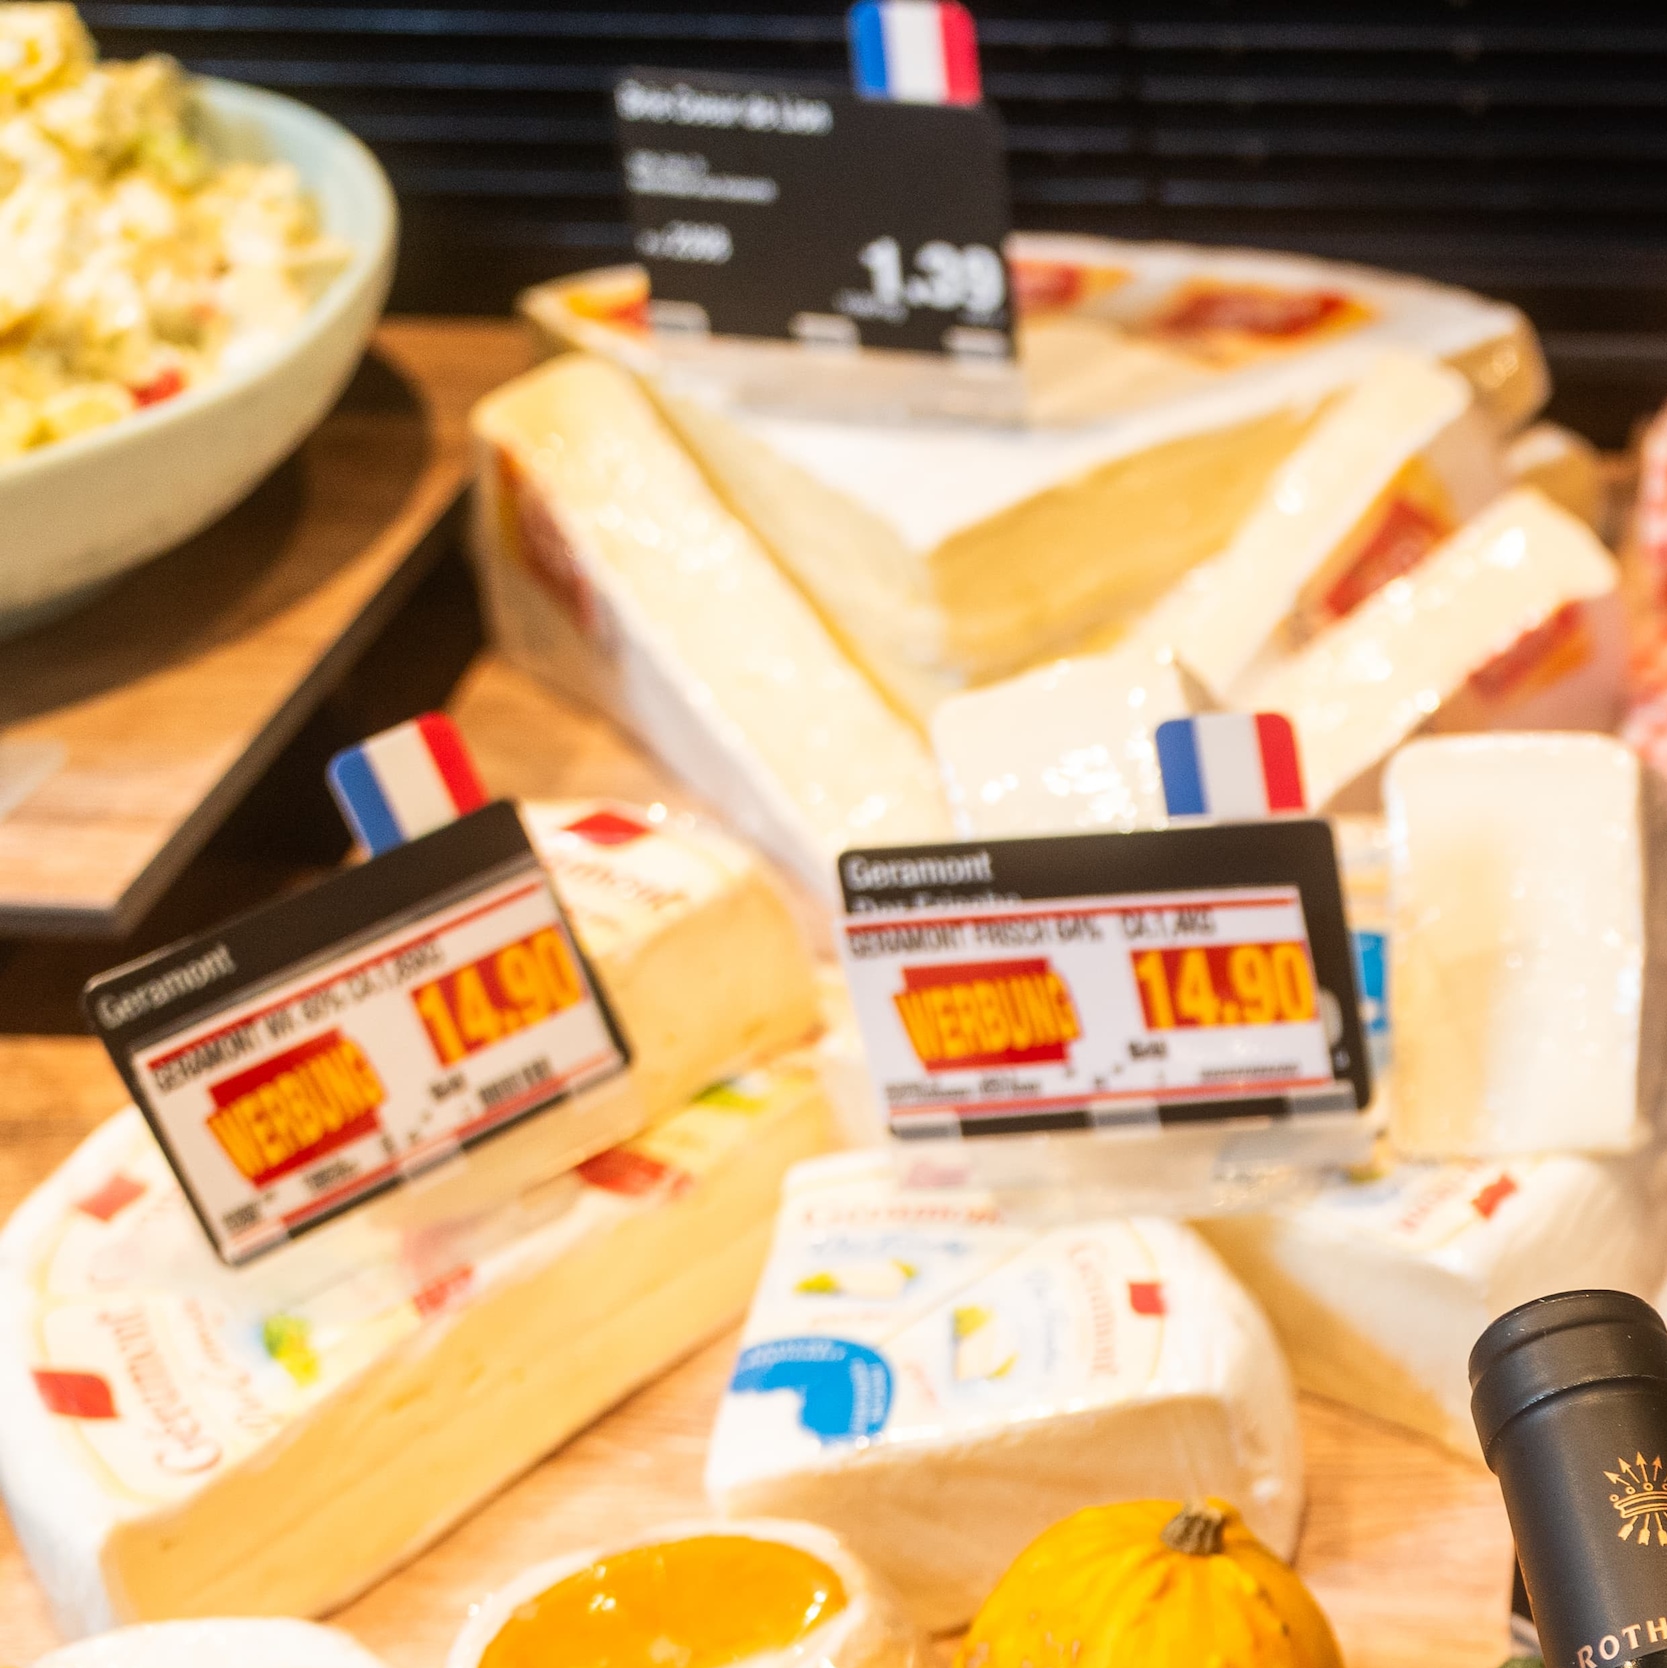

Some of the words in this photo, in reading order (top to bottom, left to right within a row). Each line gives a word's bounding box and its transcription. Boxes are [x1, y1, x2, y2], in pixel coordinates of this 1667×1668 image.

[858, 235, 1005, 312] 1.39
[846, 850, 994, 892] Geramont
[413, 927, 586, 1066] 14.90
[894, 971, 1081, 1060] WERBUNG
[1135, 941, 1318, 1030] 14.90
[205, 1035, 389, 1181] WERBUNG
